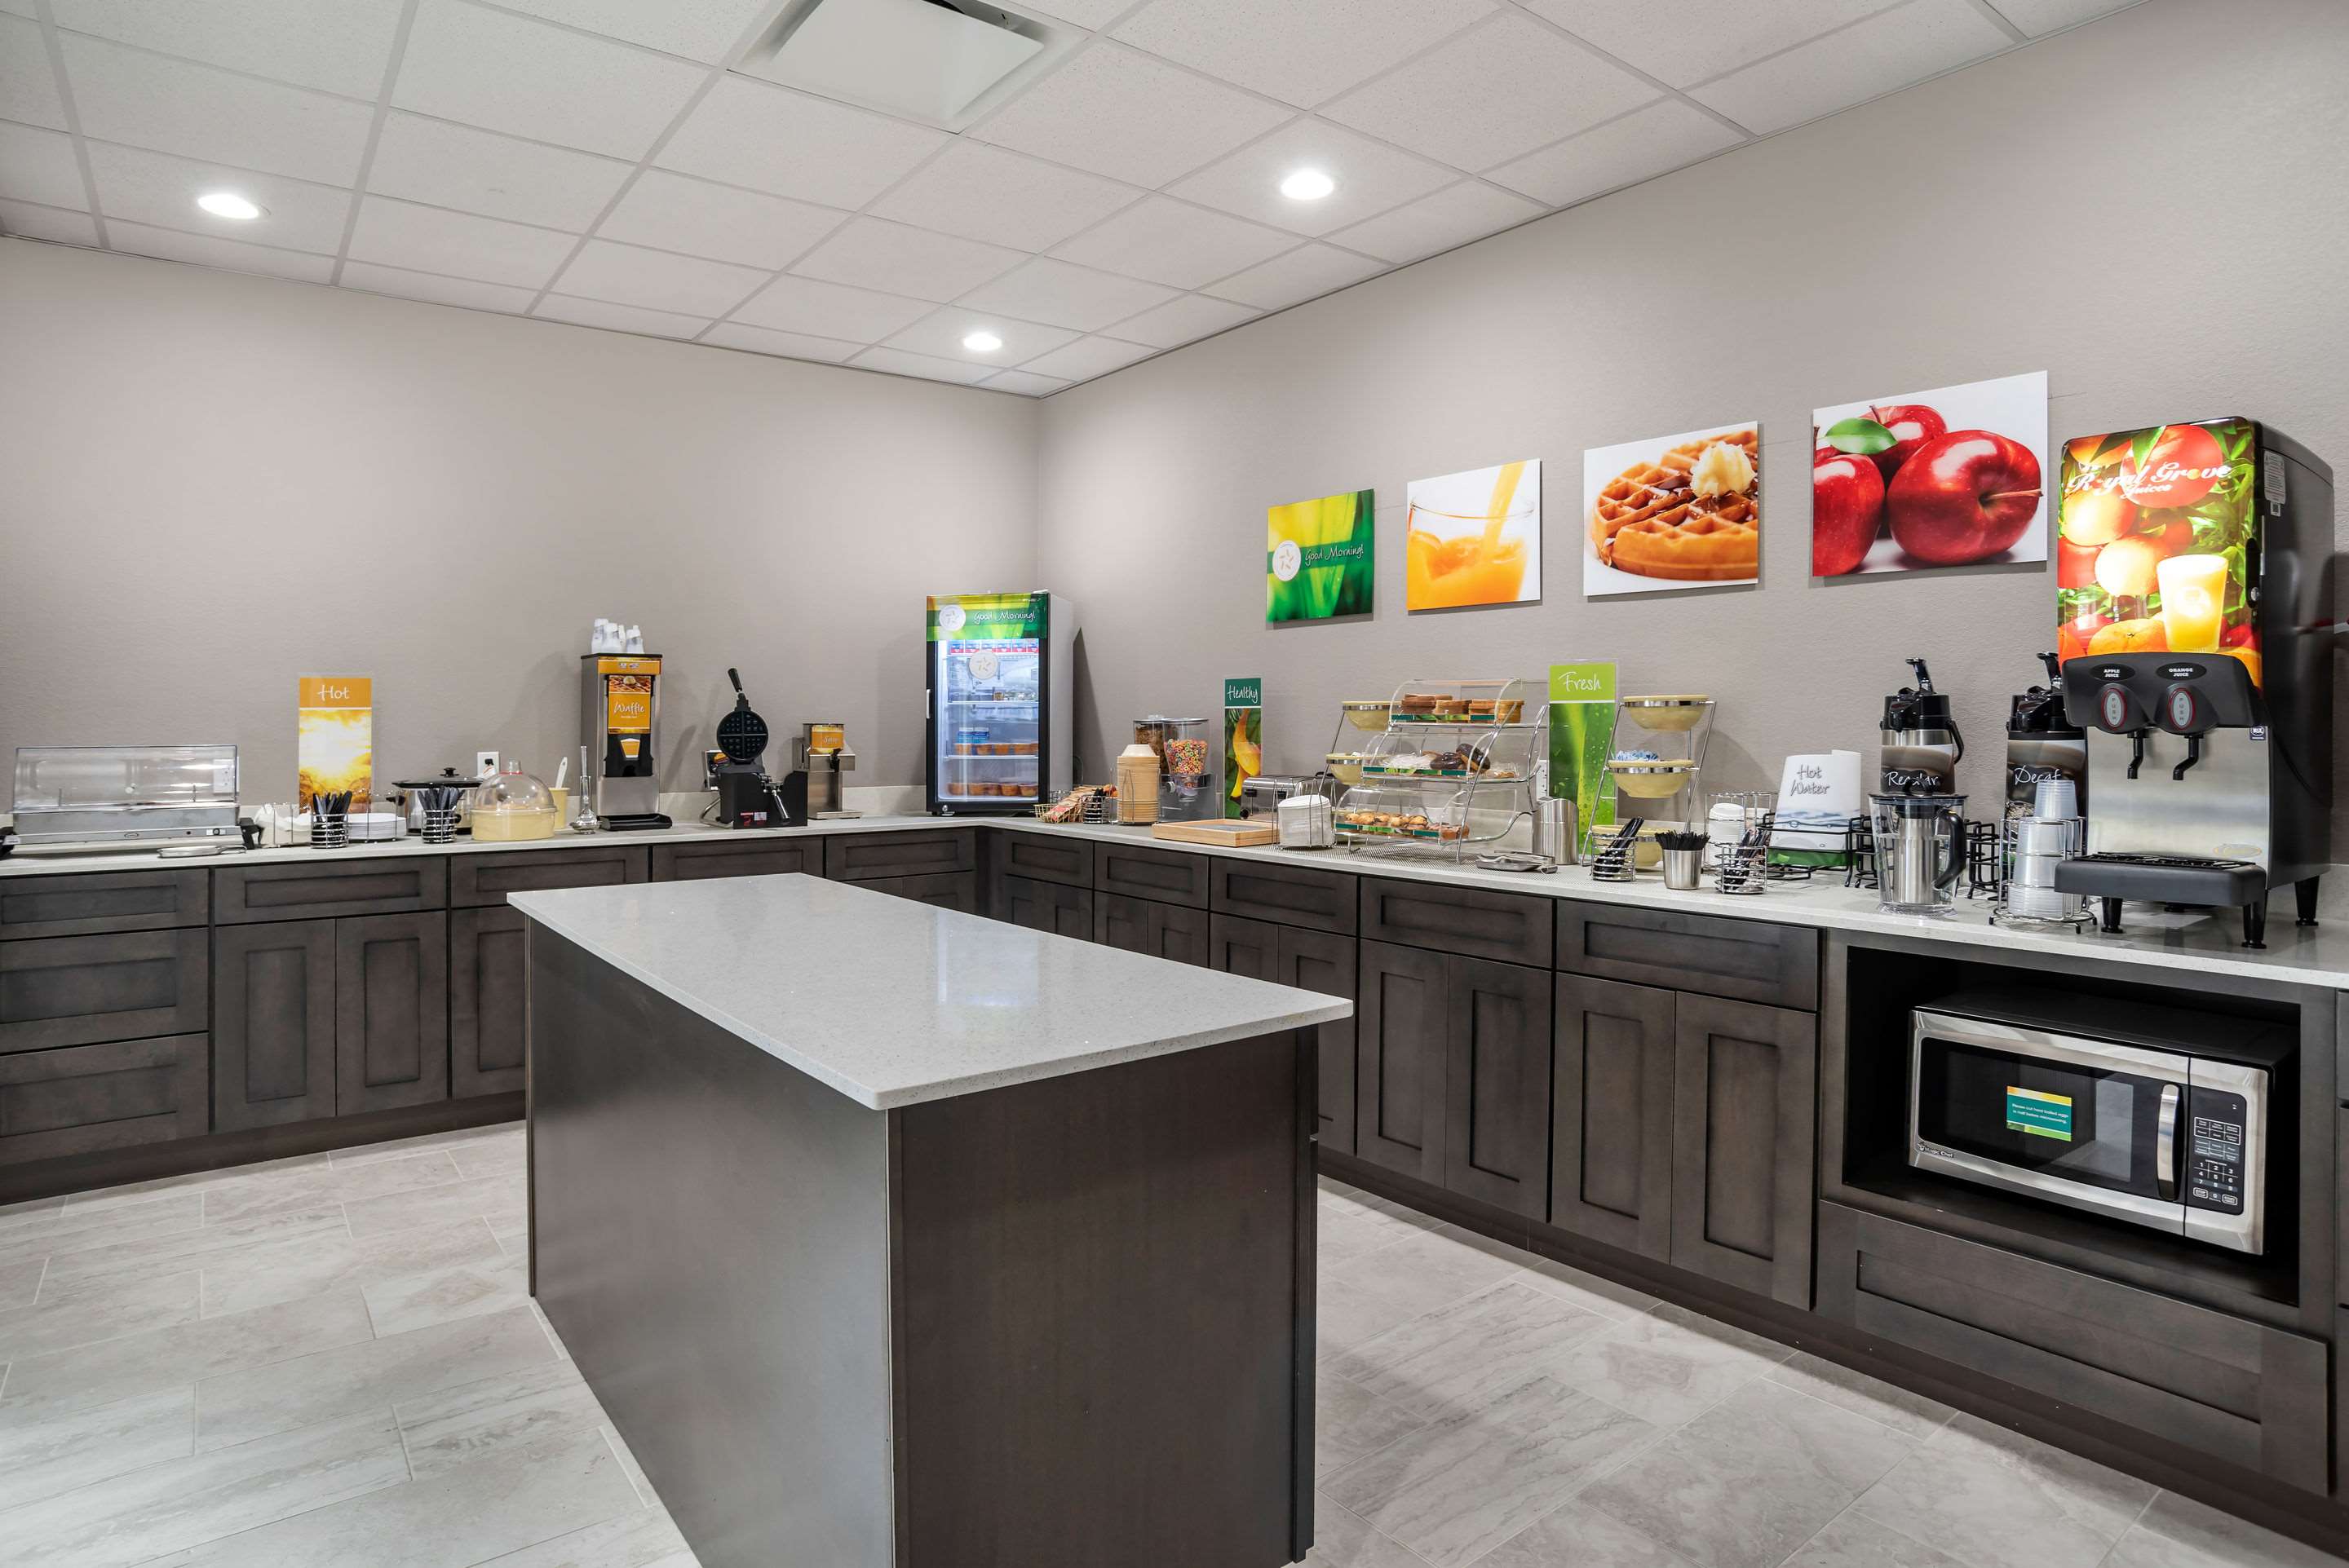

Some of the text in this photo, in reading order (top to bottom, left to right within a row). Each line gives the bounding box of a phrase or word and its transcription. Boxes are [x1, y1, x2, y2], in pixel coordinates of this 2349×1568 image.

[2151, 462, 2232, 483] Grove
[1305, 544, 1364, 567] Good Morning!
[974, 610, 1036, 625] Good Morning!
[1558, 671, 1602, 692] Fresh
[317, 684, 350, 701] Hot
[1227, 684, 1259, 704] Healthy
[613, 701, 645, 715] Waffle
[1797, 764, 1822, 780] Hot
[1790, 779, 1830, 797] Water
